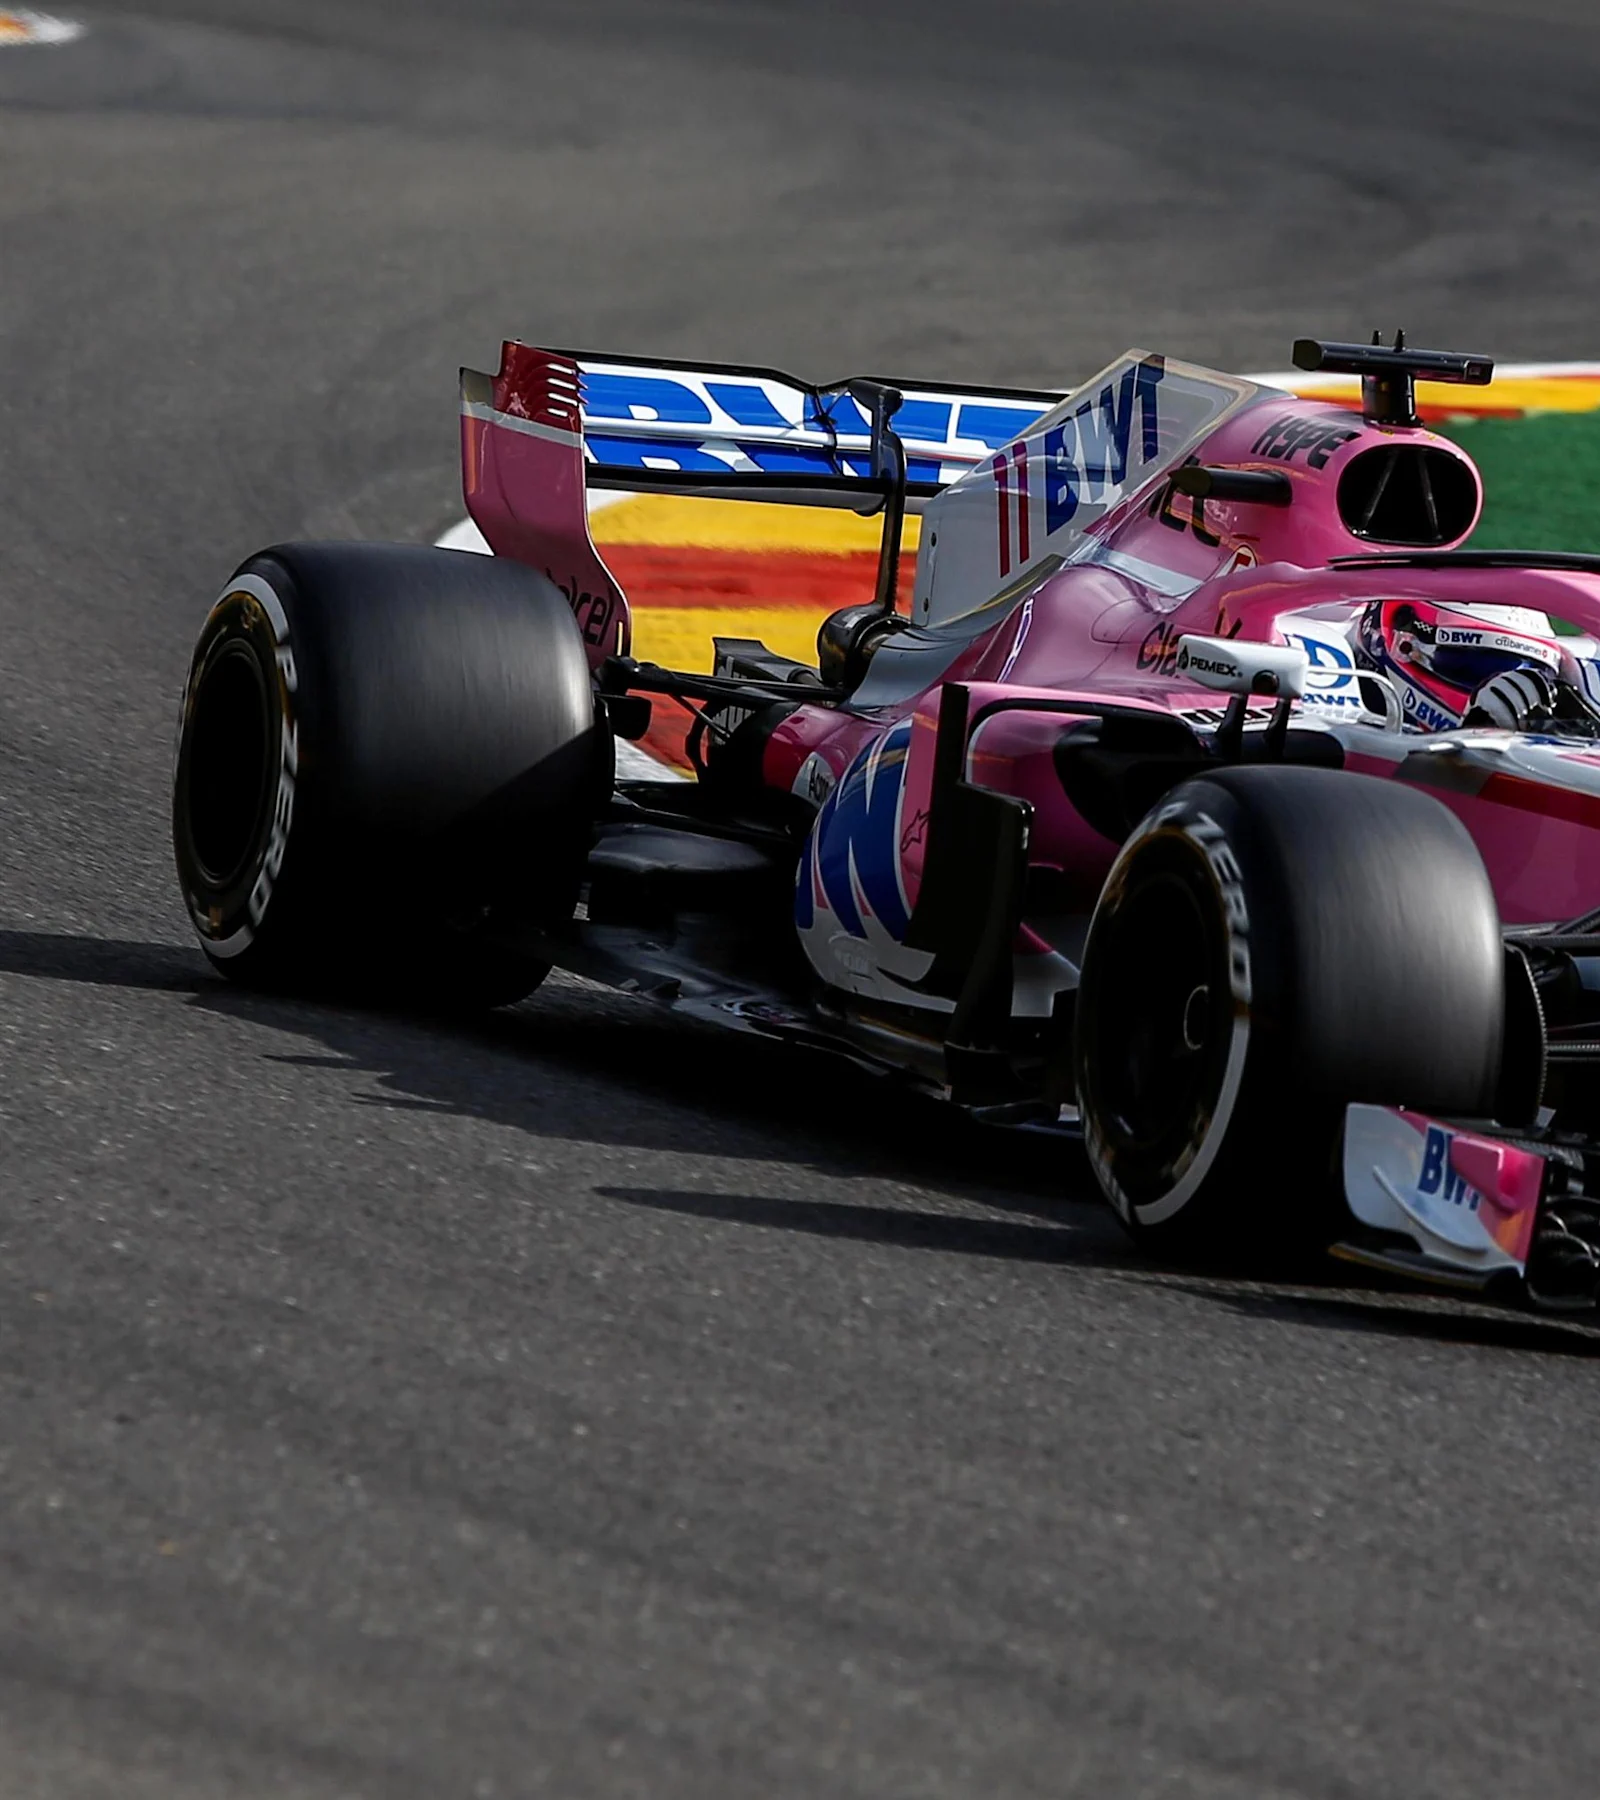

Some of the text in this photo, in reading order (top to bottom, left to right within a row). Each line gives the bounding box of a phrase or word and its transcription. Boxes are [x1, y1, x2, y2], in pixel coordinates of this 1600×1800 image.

[1044, 354, 1165, 537] BWT
[1251, 414, 1362, 470] HYPE
[992, 440, 1030, 579] 11
[1451, 631, 1483, 645] BWT
[1190, 656, 1238, 678] PEMEX
